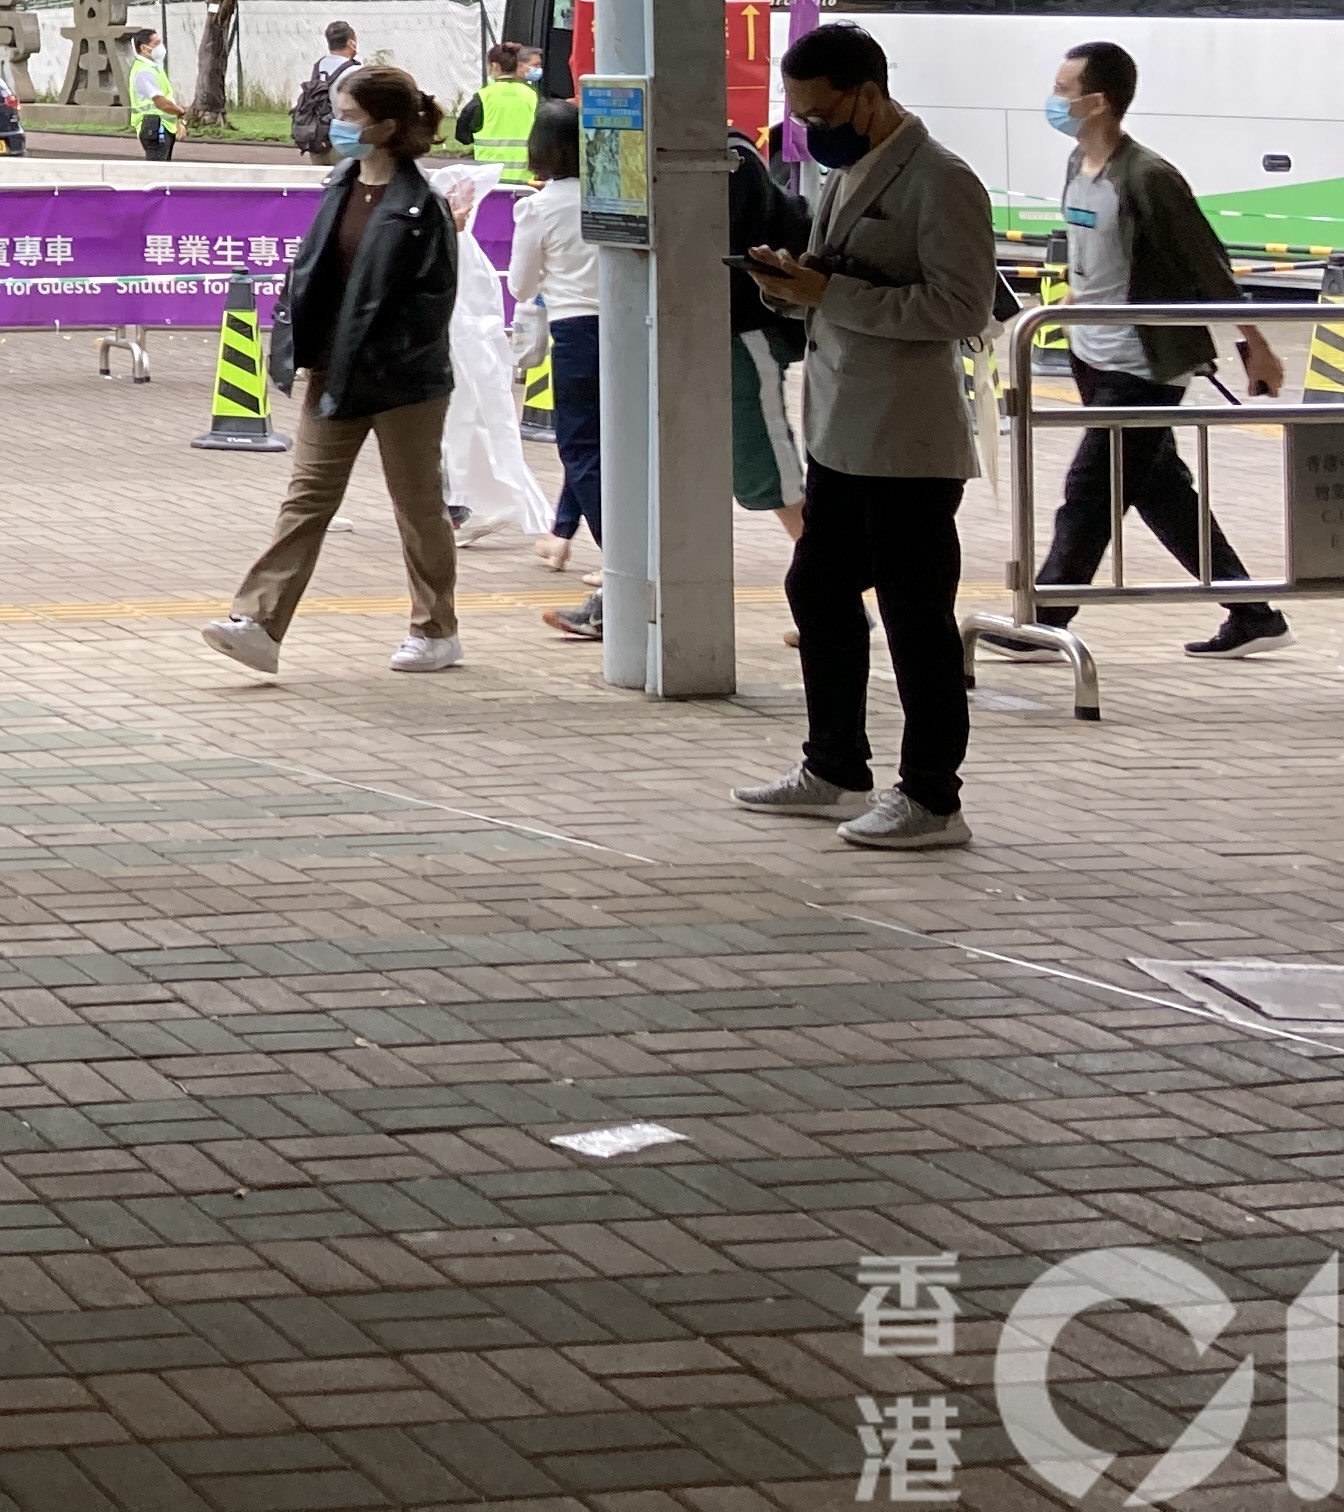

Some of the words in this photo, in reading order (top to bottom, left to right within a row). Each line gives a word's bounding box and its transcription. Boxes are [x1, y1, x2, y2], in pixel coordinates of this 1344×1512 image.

[5, 278, 32, 296] for
[37, 279, 102, 295] Guests
[116, 277, 198, 294] Shuttles
